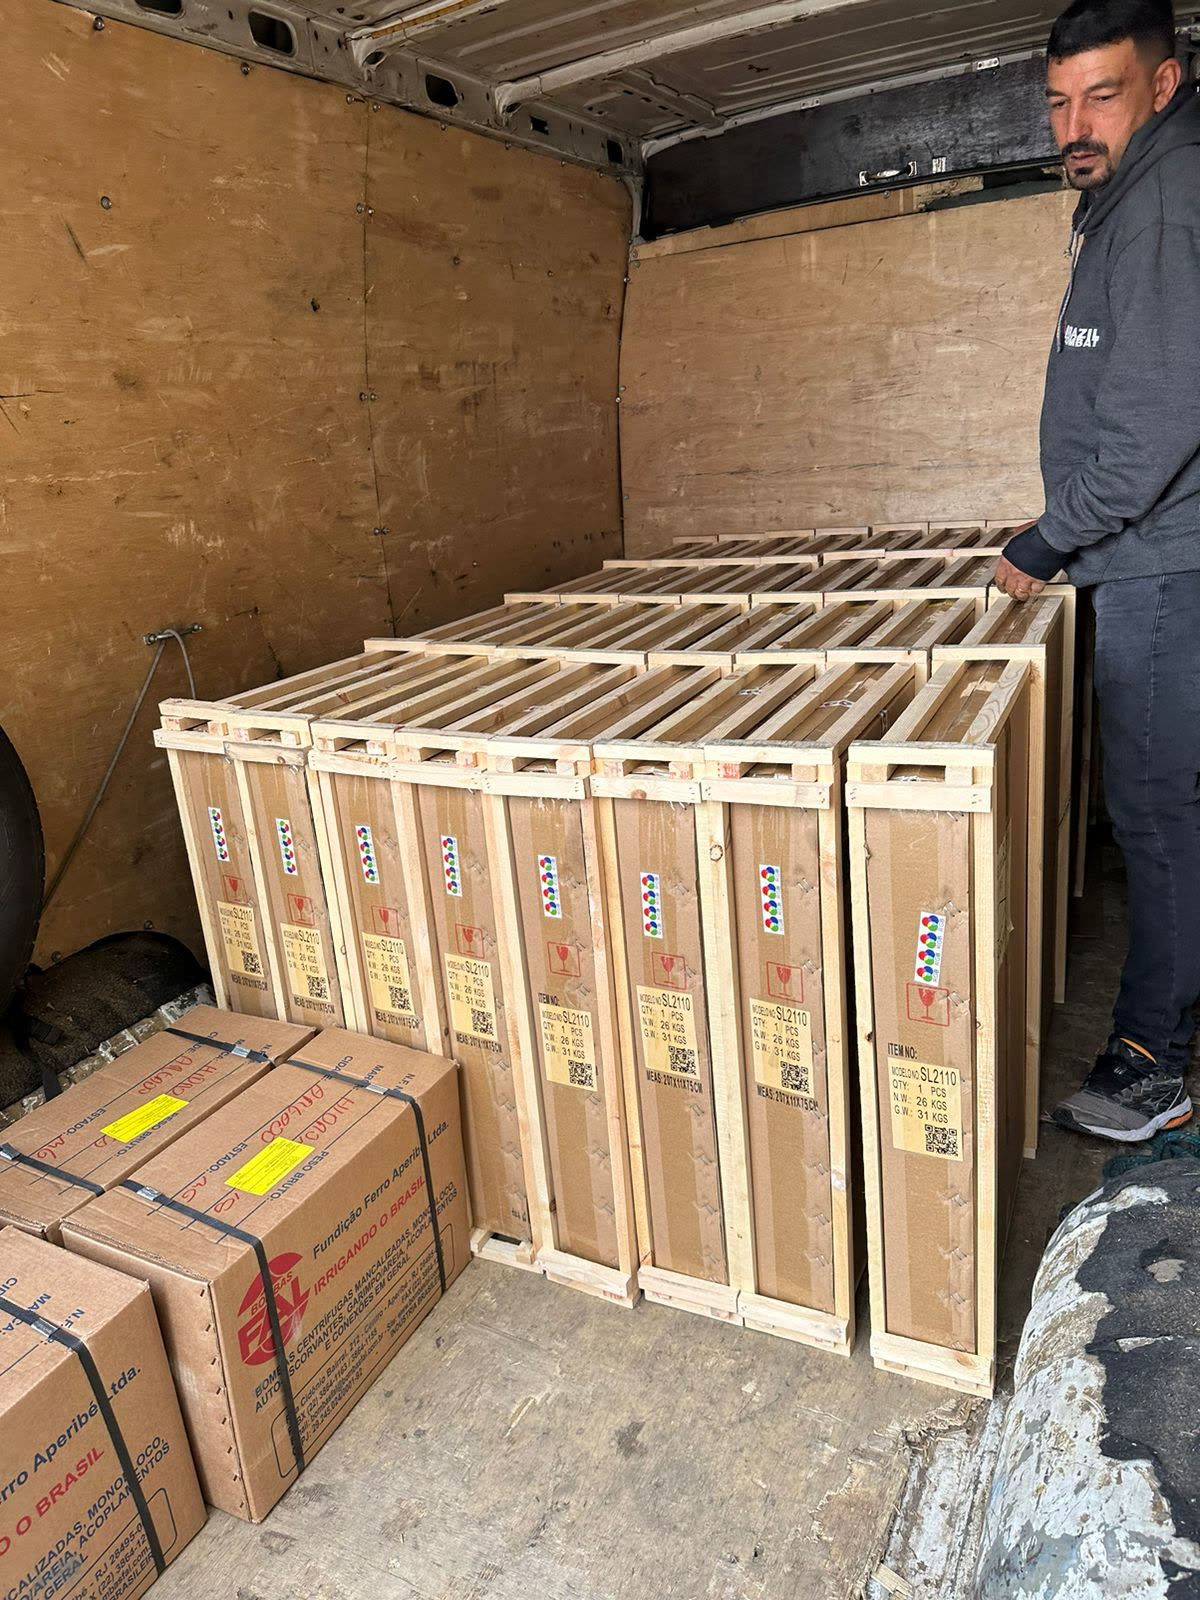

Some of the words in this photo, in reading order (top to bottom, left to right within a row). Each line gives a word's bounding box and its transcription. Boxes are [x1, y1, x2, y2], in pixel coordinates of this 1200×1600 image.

[465, 960, 489, 978] SL2110
[661, 993, 690, 1011] SL2110
[562, 1010, 590, 1028] SL2110
[660, 1019, 670, 1030] 26
[671, 1021, 685, 1033] KGS
[670, 1010, 683, 1021] PCS
[776, 1006, 808, 1027] SL2110
[560, 1035, 570, 1045] 26
[571, 1037, 584, 1048] KGS
[570, 1026, 583, 1037] PCS
[661, 1031, 671, 1041] 31
[673, 1033, 686, 1045] KGS
[785, 1025, 799, 1037] PCS
[561, 1046, 571, 1056] 31
[572, 1048, 585, 1059] KGS
[772, 1034, 783, 1045] 26
[785, 1037, 800, 1050] KGS
[887, 1042, 903, 1056] ITEM
[904, 1045, 917, 1059] NO:
[773, 1046, 784, 1057] 31
[786, 1049, 801, 1062] KGS
[323, 1055, 354, 1081] CIDAE:
[919, 1066, 957, 1087] SL2110
[892, 1079, 909, 1091] QTY:
[930, 1085, 946, 1098] PCS
[915, 1095, 928, 1107] 26
[930, 1098, 947, 1111] KGS
[64, 1108, 107, 1137] ESTADO:
[916, 1108, 928, 1120] 31
[931, 1111, 948, 1124] KGS
[205, 1142, 249, 1174] ESTADO:
[302, 1150, 330, 1171] PESO
[269, 1172, 305, 1201] BRUTO:
[312, 1204, 362, 1262] Fundição
[363, 1175, 390, 1210] Ferro
[391, 1142, 423, 1182] Aperib
[426, 1116, 449, 1146] Ltda.
[406, 1186, 457, 1251] ACOPLAENTOS
[313, 1220, 379, 1296] IRRIGANDO
[379, 1211, 387, 1228] O
[389, 1172, 425, 1217] BRASIL
[296, 1286, 353, 1356] CENTRÍFUGAS
[412, 1179, 453, 1231] MONOLOCO,
[250, 1271, 293, 1314] BOBAS
[325, 1337, 330, 1350] E
[332, 1289, 373, 1344] CONEXÕES
[374, 1276, 386, 1296] EM
[386, 1249, 410, 1283] GERAL
[0, 1293, 52, 1335] MACA:
[27, 1397, 100, 1475] Aperibé
[104, 1358, 141, 1402] tda.
[12, 1512, 34, 1538] O
[32, 1441, 106, 1518] BRASIL
[40, 1549, 90, 1600] GERAL
[93, 1563, 109, 1582] RJ
[95, 1570, 115, 1595] (22)
